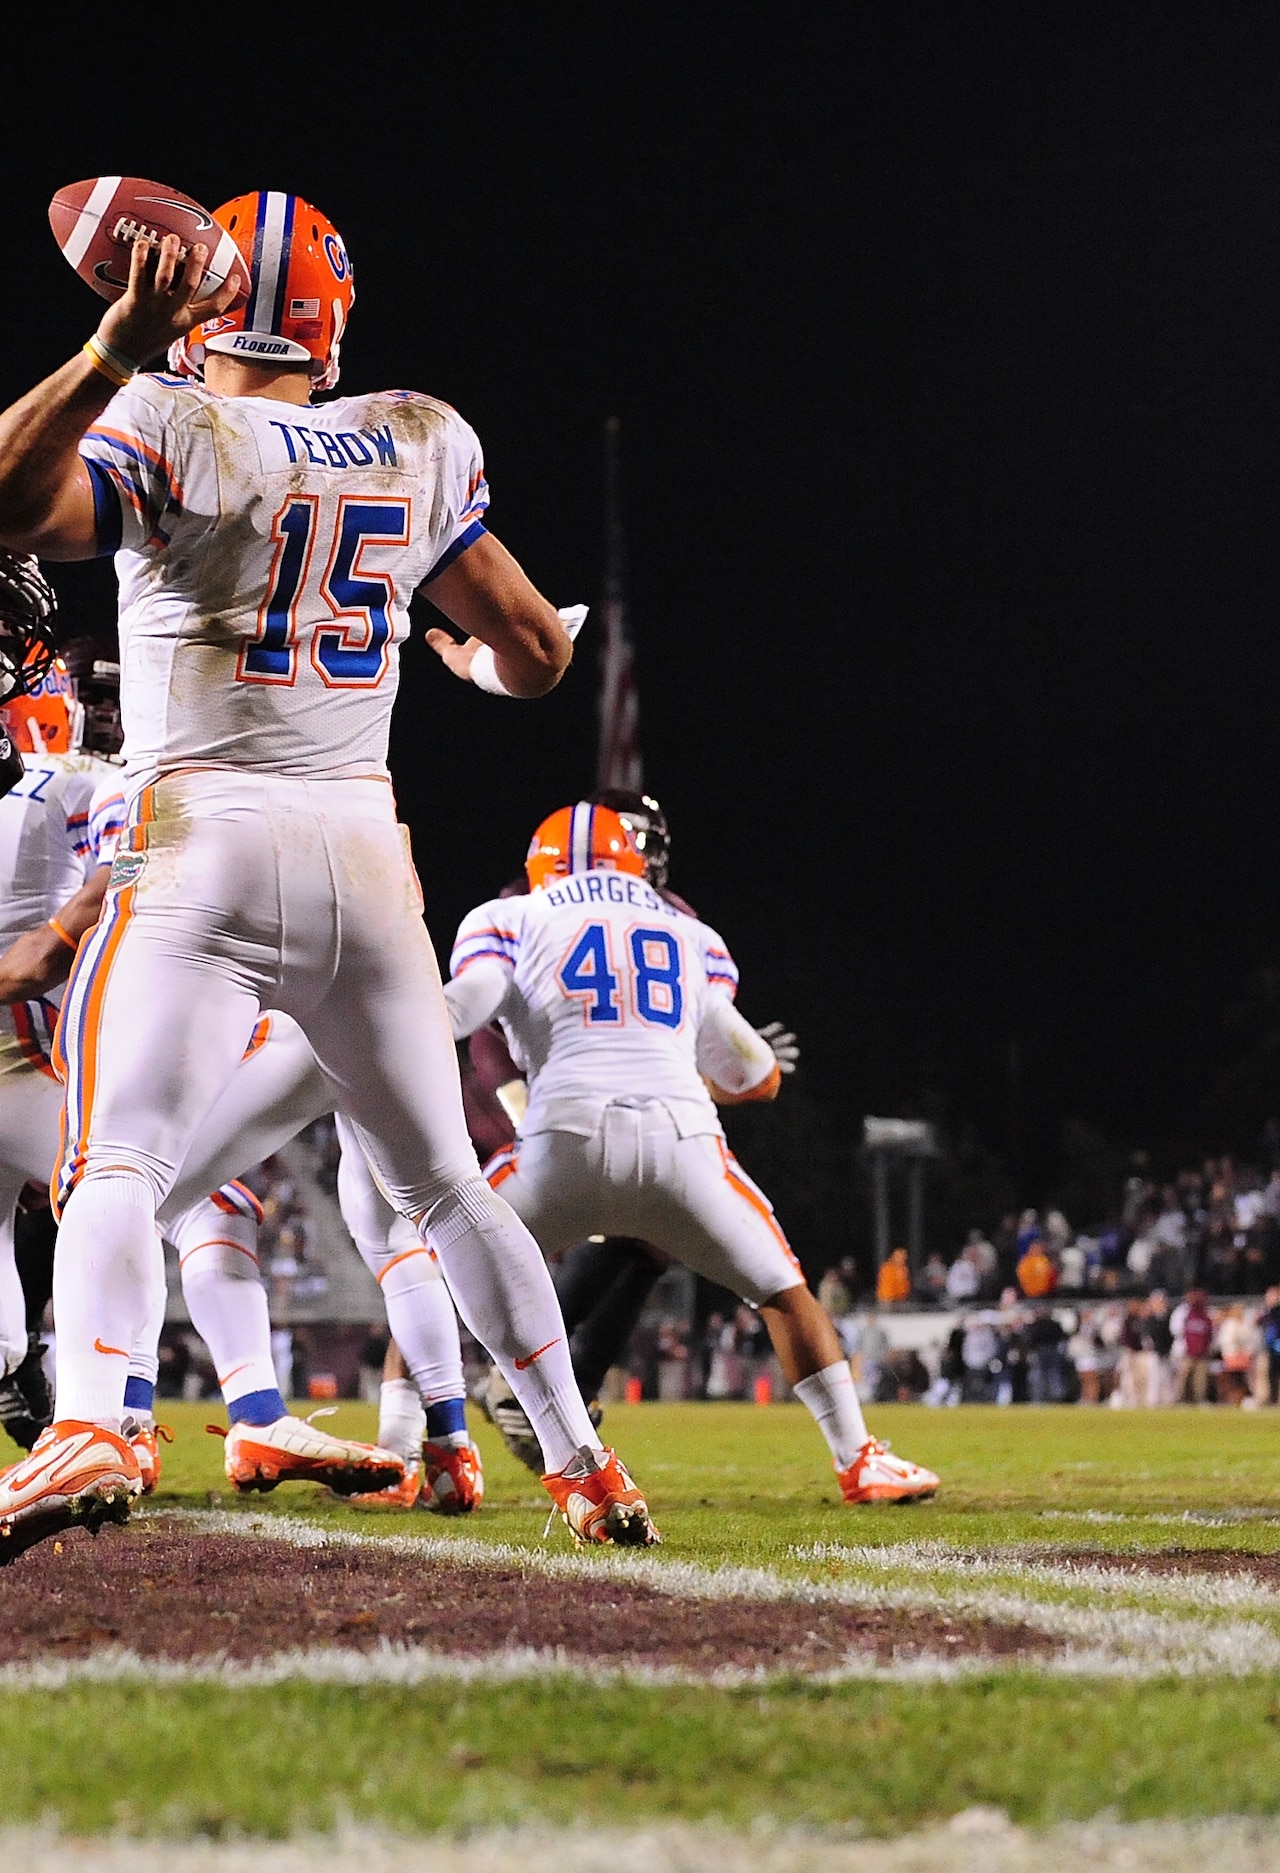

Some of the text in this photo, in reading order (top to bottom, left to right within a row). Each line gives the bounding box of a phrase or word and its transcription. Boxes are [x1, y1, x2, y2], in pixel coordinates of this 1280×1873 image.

[232, 335, 290, 355] FLORIDA
[269, 420, 398, 469] TEBOW
[234, 493, 412, 689] 15
[554, 918, 686, 1036] 48
